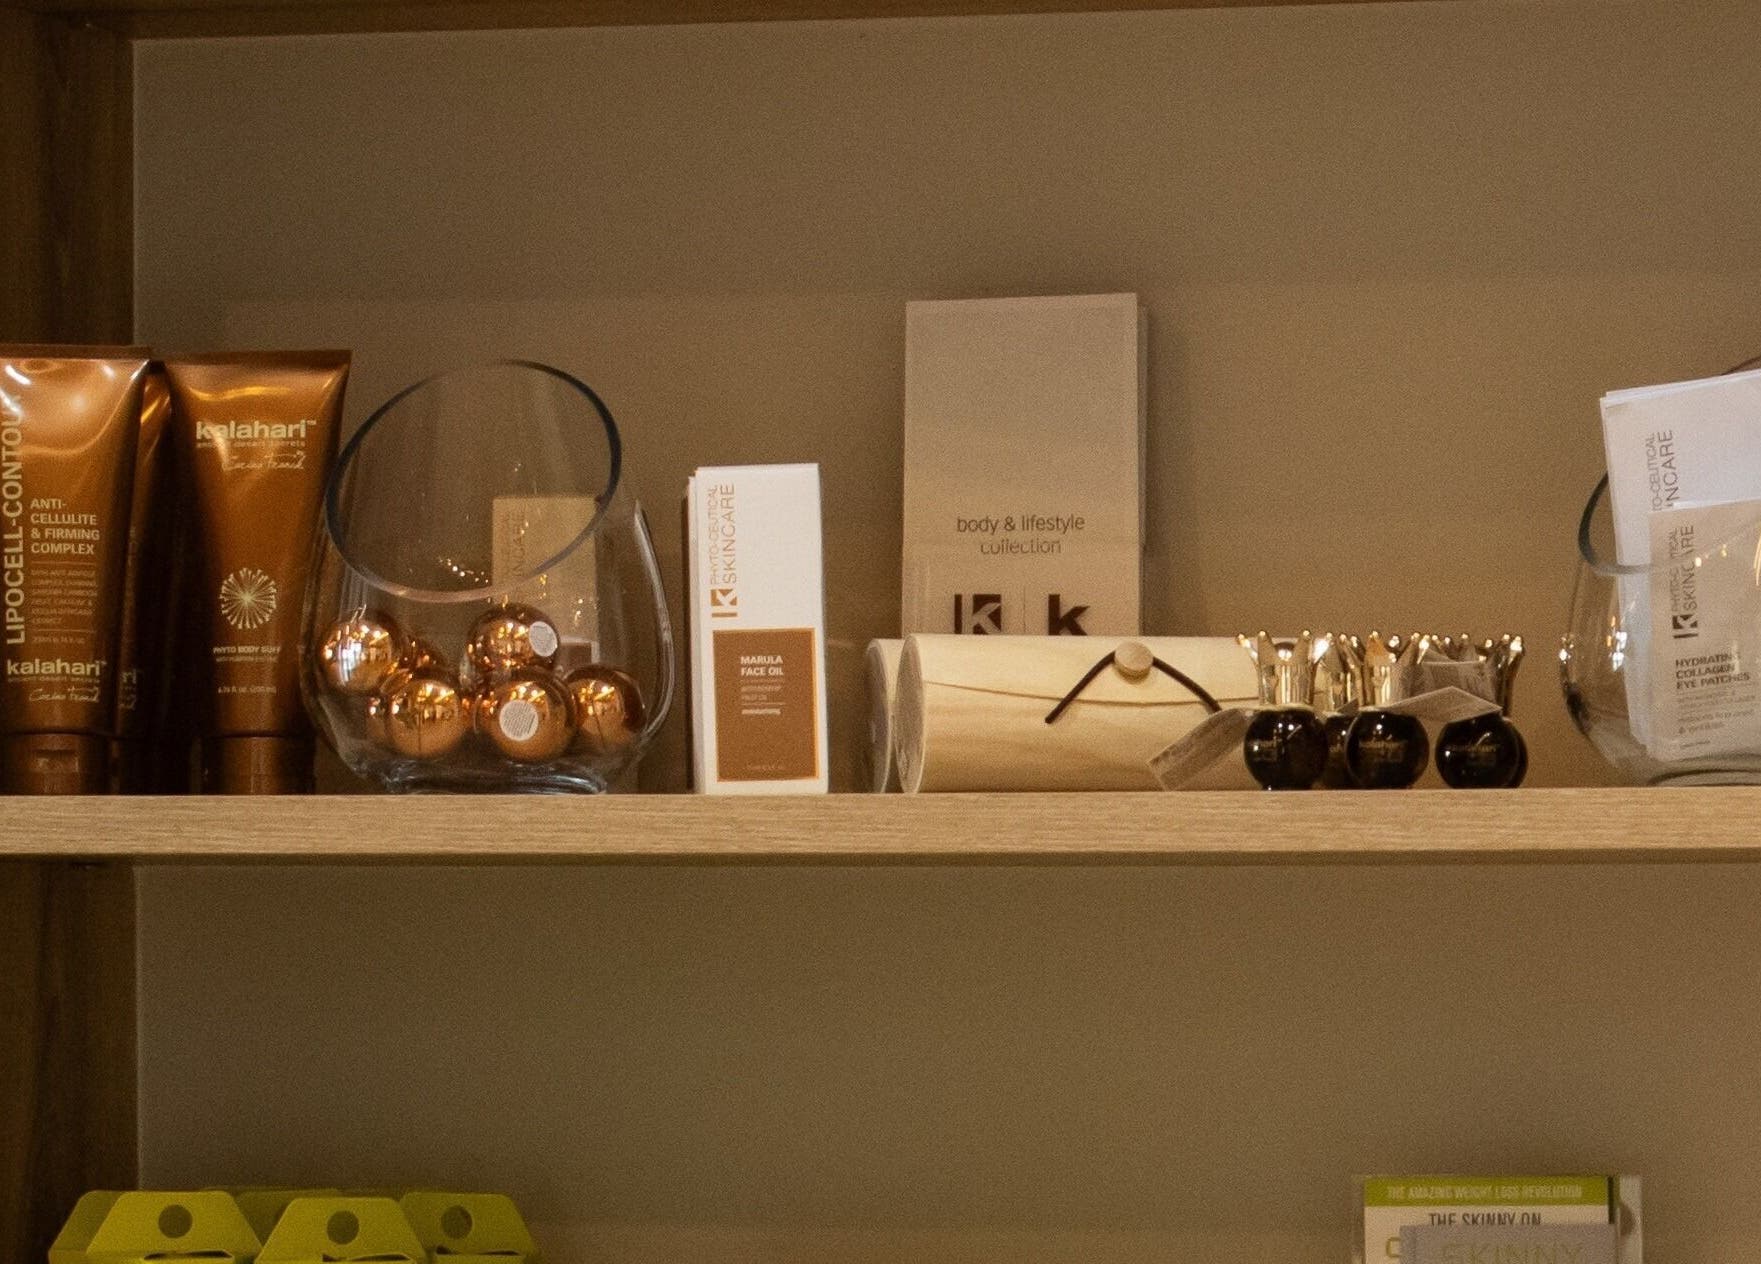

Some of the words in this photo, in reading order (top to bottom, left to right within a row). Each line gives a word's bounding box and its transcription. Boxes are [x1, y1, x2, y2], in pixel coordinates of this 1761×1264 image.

[195, 420, 307, 440] kalahari
[30, 498, 67, 509] ANTI-
[2, 396, 25, 644] LIPOCELL-CONTOU
[31, 513, 97, 525] CELLULITE
[957, 517, 999, 533] body
[1004, 517, 1016, 531] &
[1022, 514, 1086, 534] lifestyle
[31, 528, 40, 539] &
[45, 528, 100, 540] FIRMING
[721, 483, 737, 584] SKINCARE
[31, 543, 94, 555] COMPLEX
[981, 538, 1061, 555] collection
[740, 655, 783, 665] MARULA
[7, 658, 101, 675] kalahari
[741, 667, 766, 677] FACE
[768, 666, 784, 676] OIL
[1677, 681, 1696, 689] EYE
